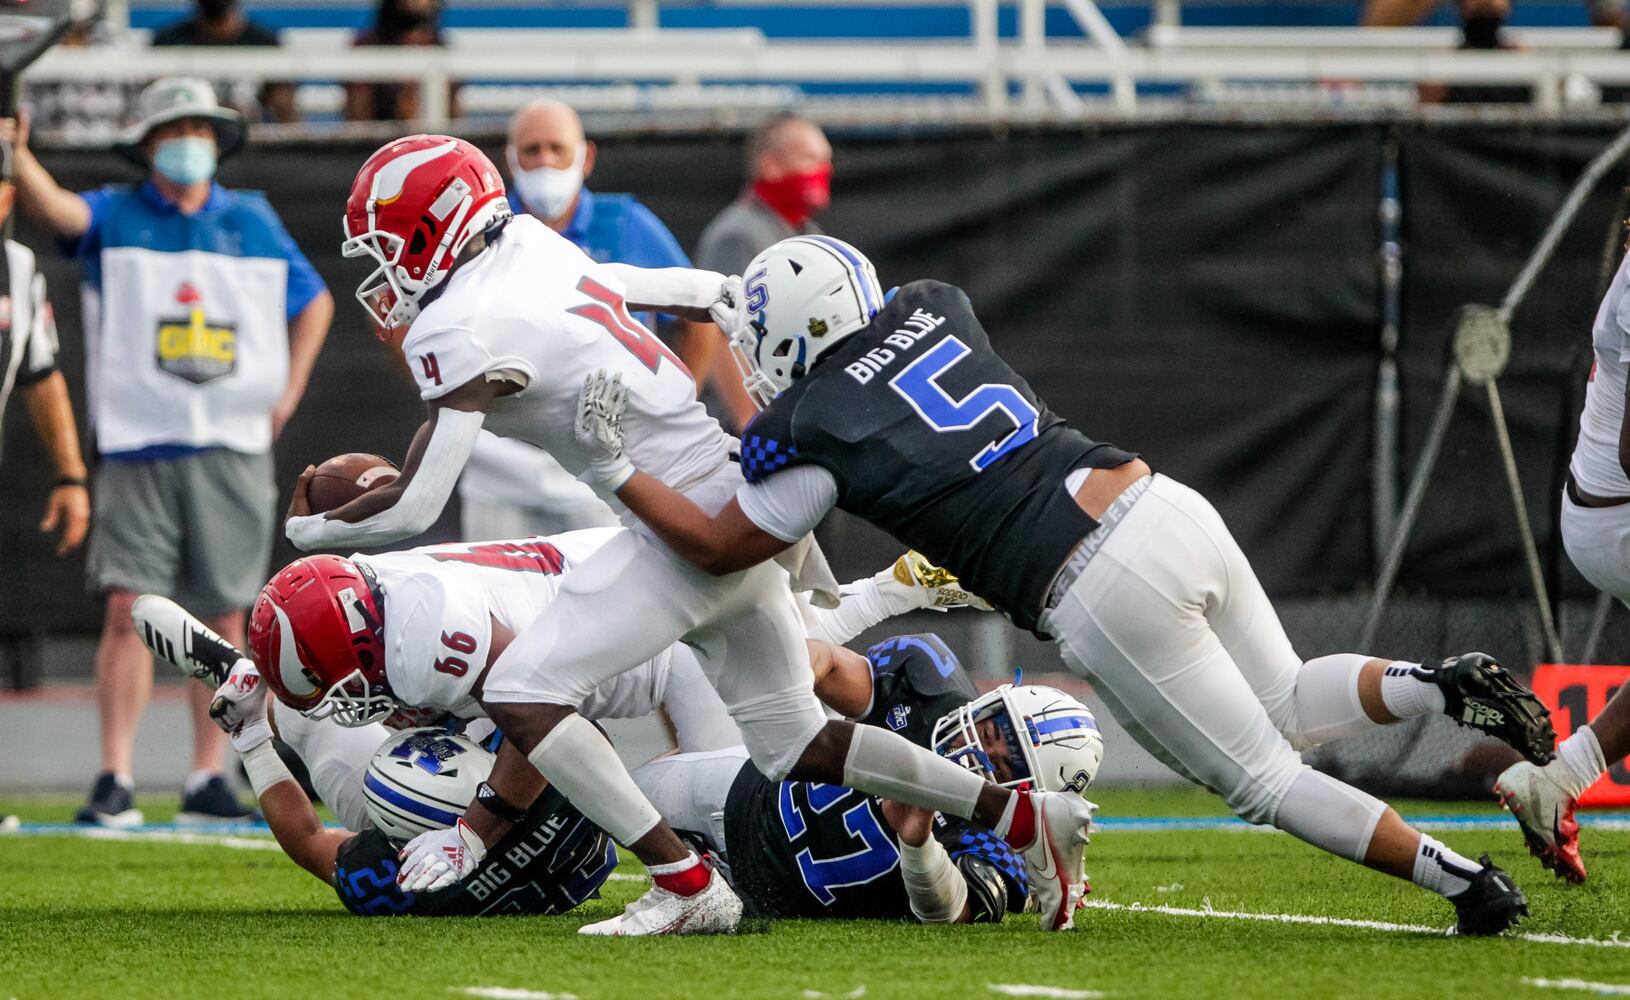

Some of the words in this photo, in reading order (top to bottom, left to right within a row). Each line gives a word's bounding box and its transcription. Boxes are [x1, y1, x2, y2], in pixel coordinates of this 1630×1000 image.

[424, 260, 440, 287] schutt
[745, 268, 770, 315] 5
[419, 351, 444, 387] 4
[843, 346, 897, 386] BIG
[883, 307, 947, 351] BLUE
[887, 333, 1041, 473] 5
[1068, 521, 1111, 576] NIKE
[433, 629, 478, 678] 66
[465, 861, 512, 902] BIG
[505, 812, 569, 869] BLUE
